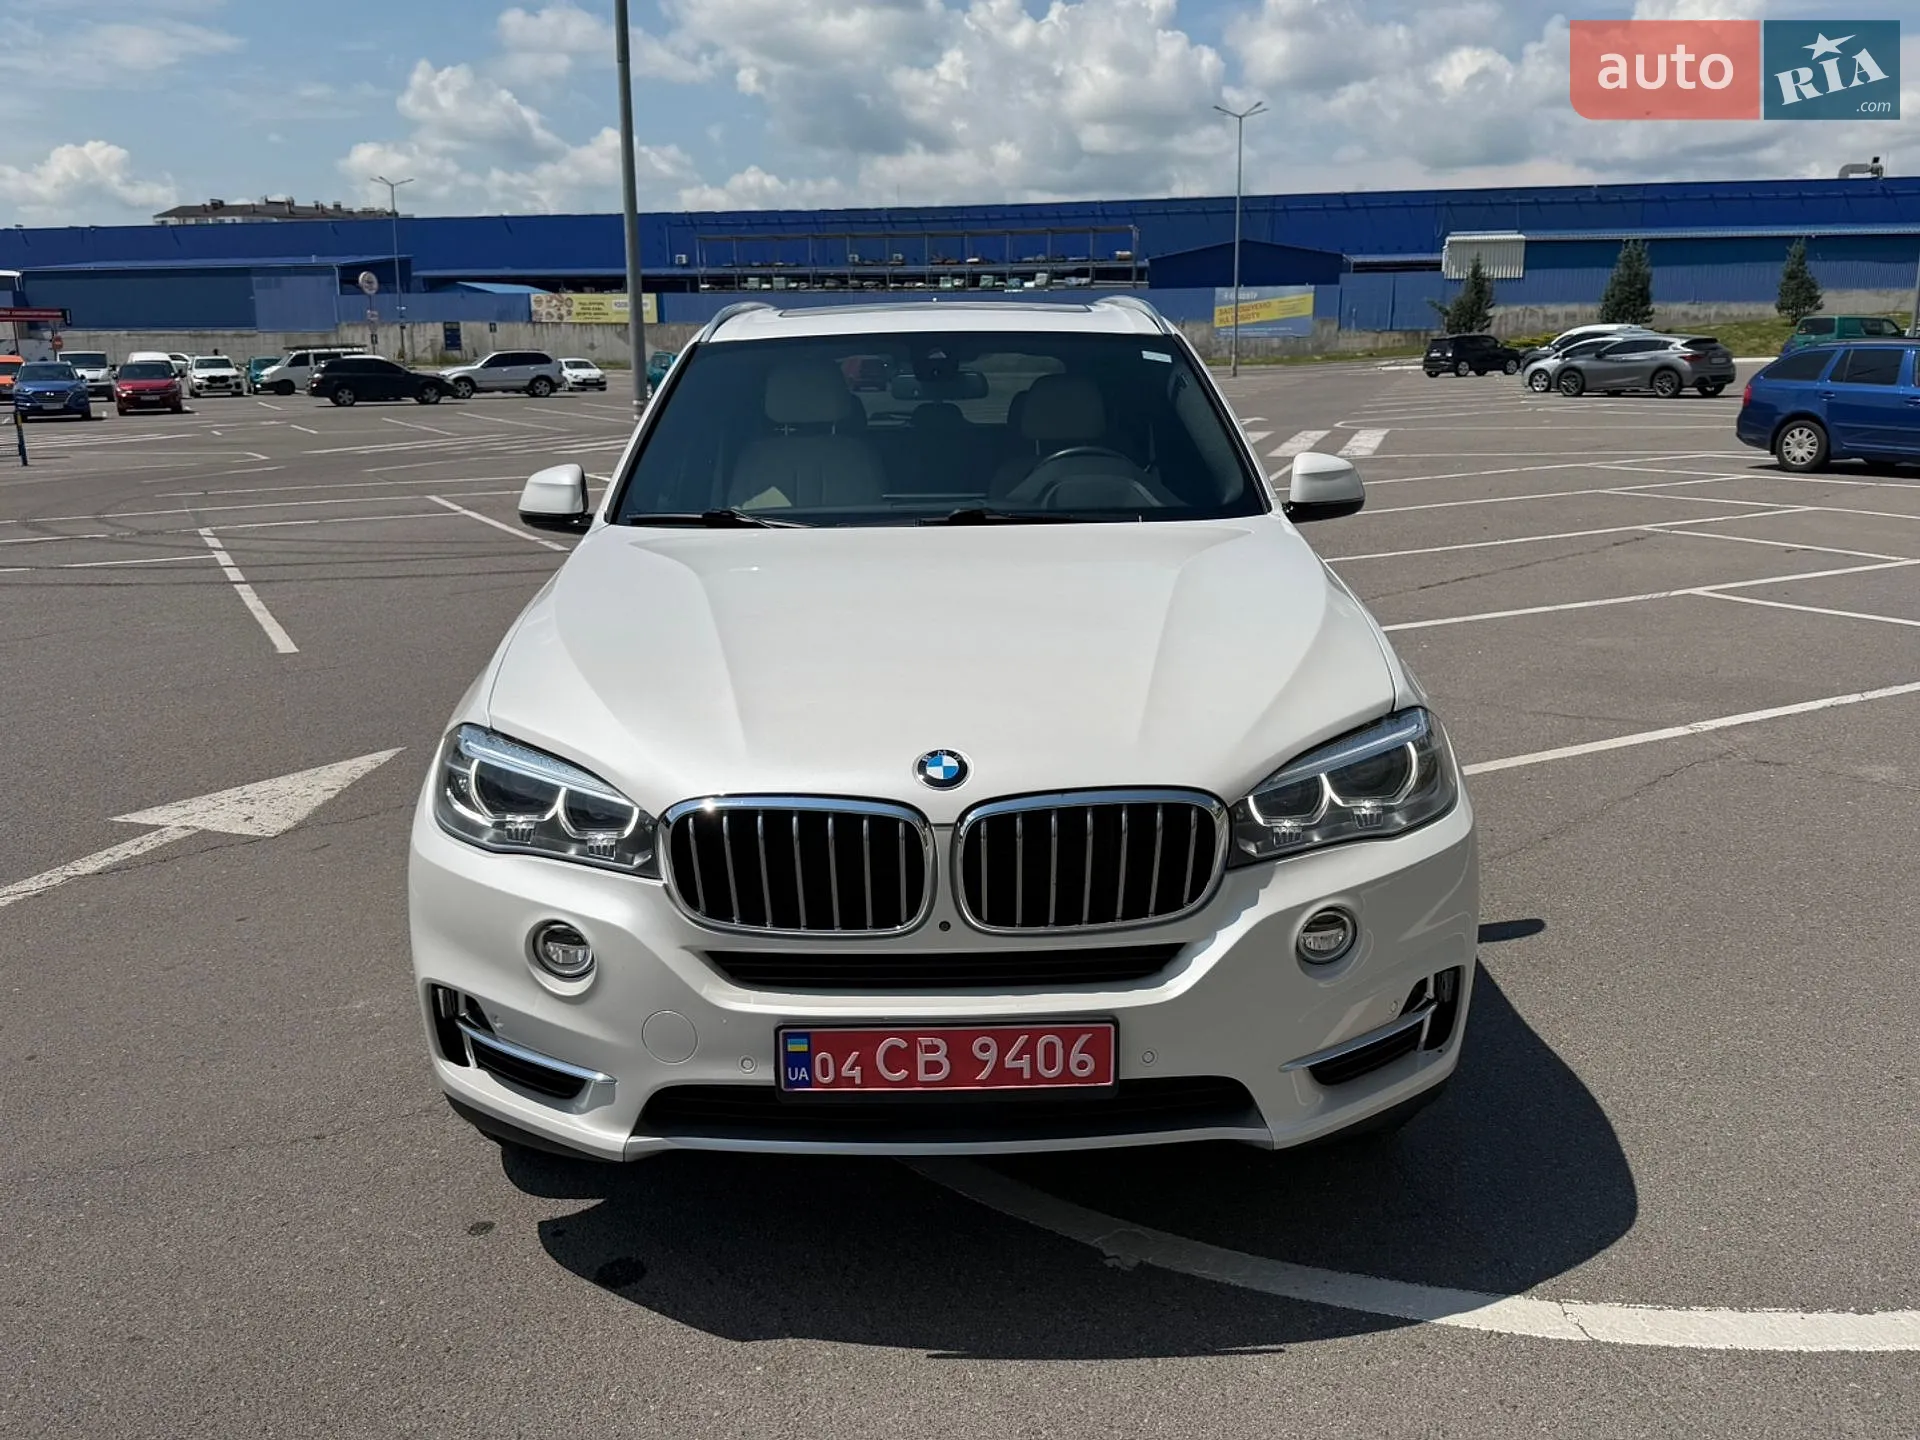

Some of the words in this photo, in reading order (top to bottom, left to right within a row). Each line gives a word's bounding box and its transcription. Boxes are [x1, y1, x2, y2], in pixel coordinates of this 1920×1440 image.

[787, 1067, 809, 1081] UA
[814, 1051, 862, 1084] 04
[876, 1037, 951, 1082] CB
[971, 1034, 1096, 1080] 9406
